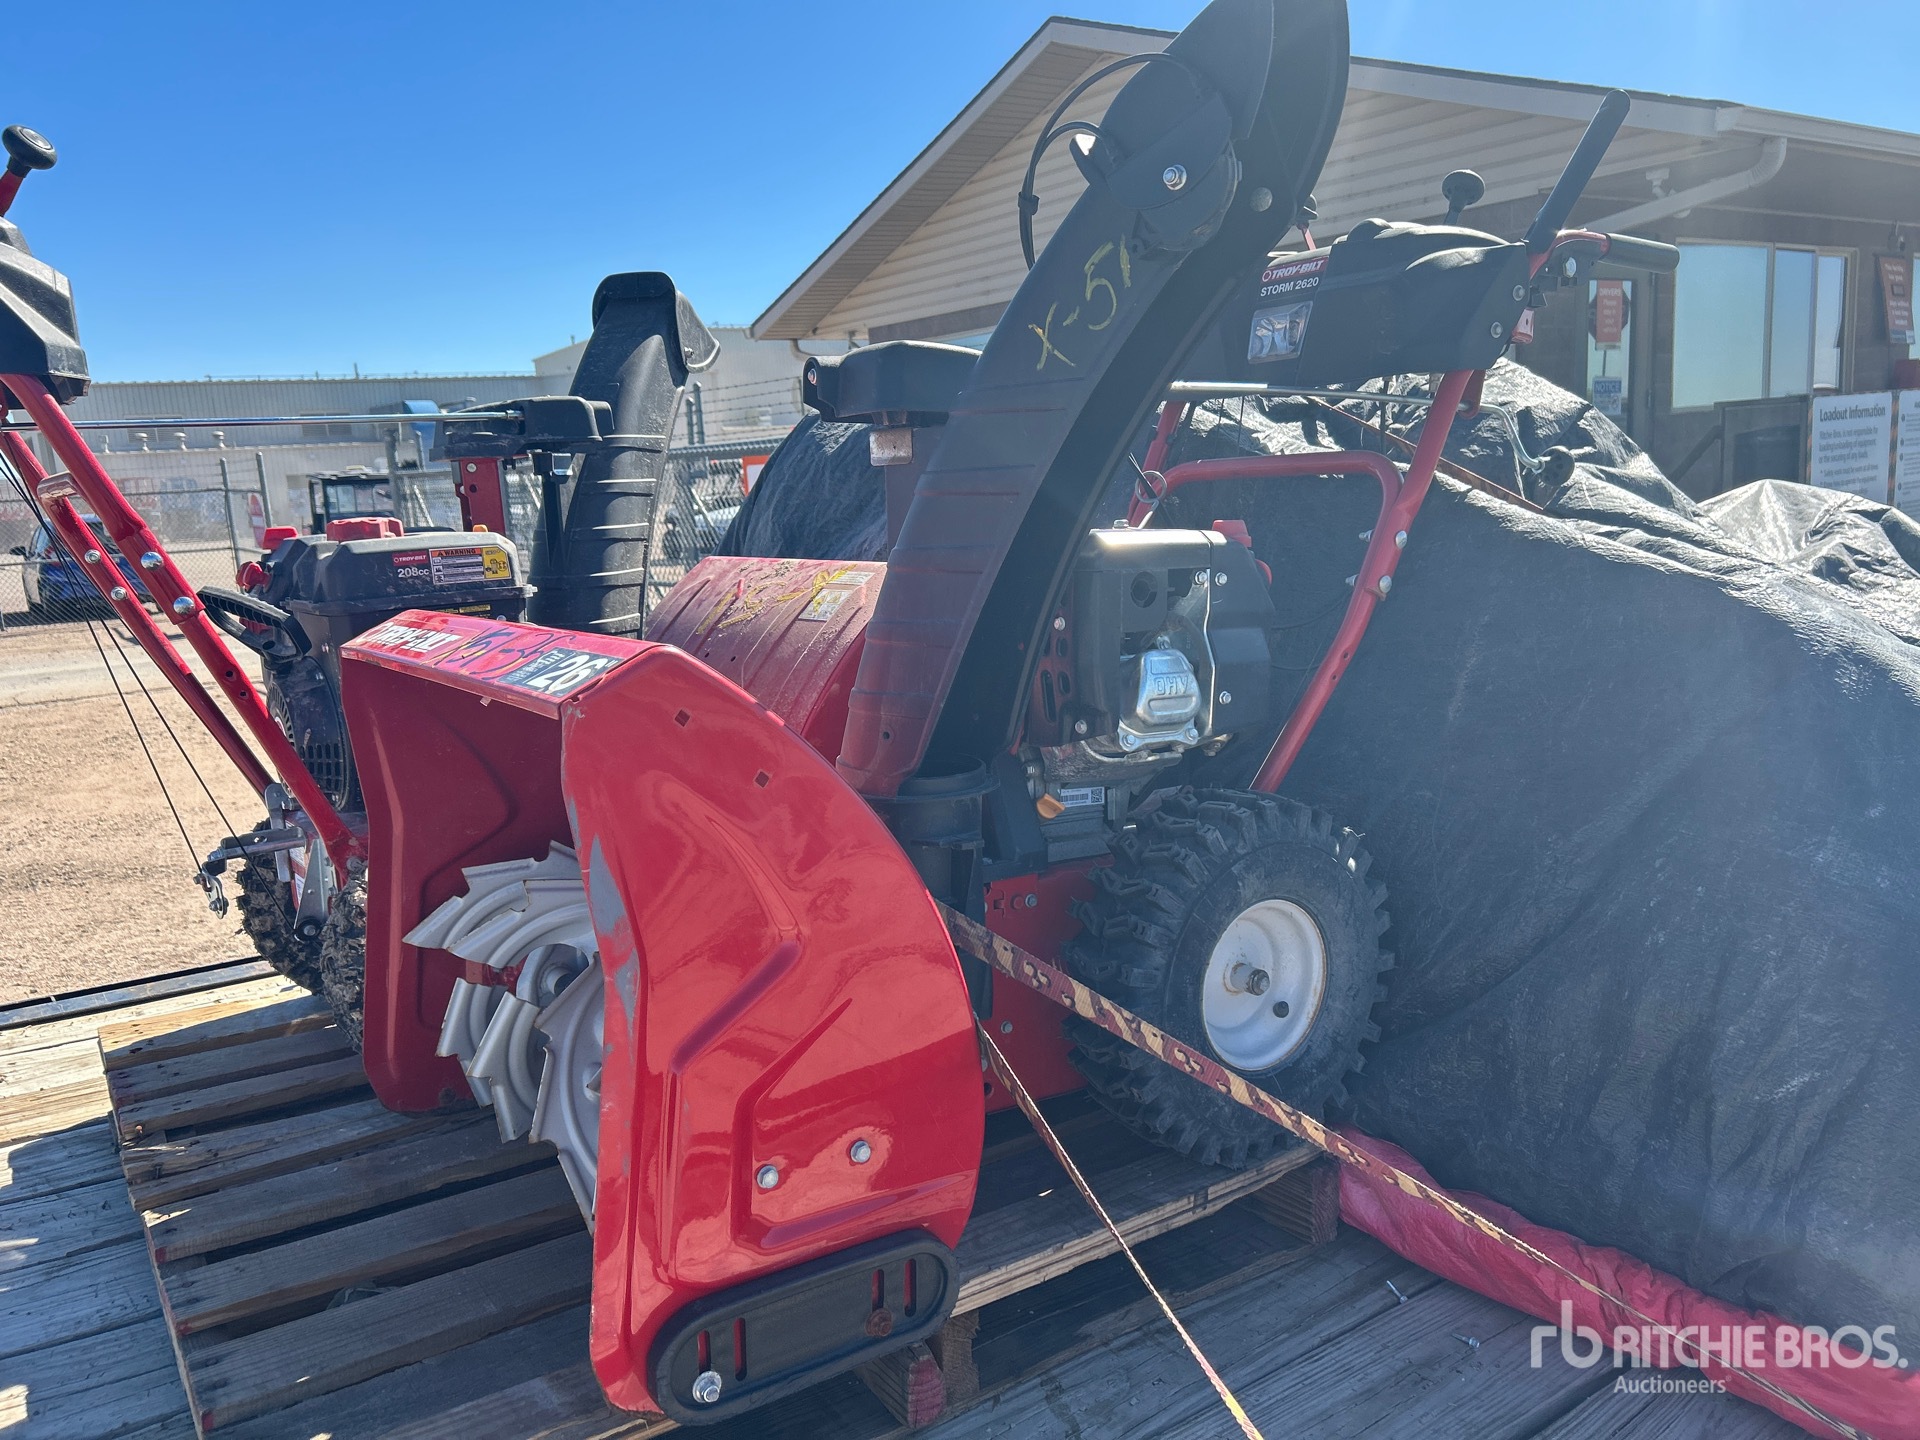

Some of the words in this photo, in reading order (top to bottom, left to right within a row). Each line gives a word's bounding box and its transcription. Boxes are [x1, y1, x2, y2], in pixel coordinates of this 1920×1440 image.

[1271, 260, 1325, 280] TROY-BILT
[1260, 282, 1294, 297] STORM
[1295, 277, 1319, 290] 2620
[1820, 407, 1848, 422] Loadout
[1849, 404, 1886, 419] Information
[399, 554, 427, 562] TROY-BILT
[445, 548, 477, 557] WARNING
[397, 567, 430, 578] 208cc
[1153, 675, 1189, 696] OHV
